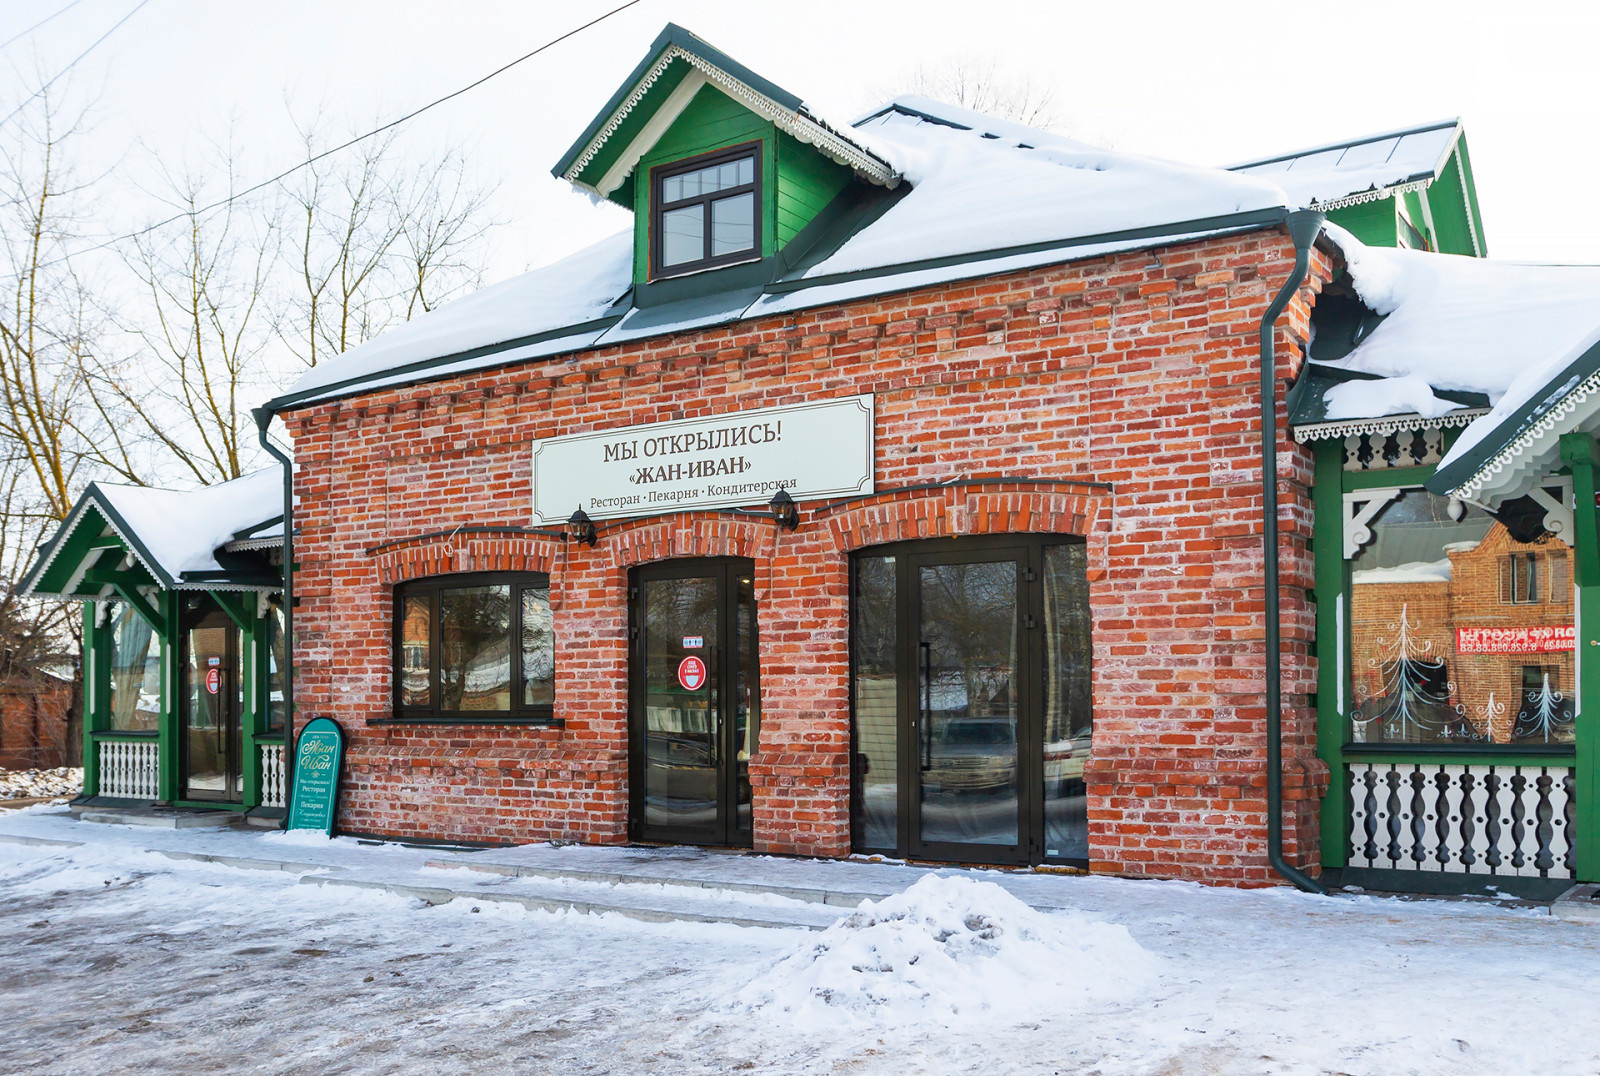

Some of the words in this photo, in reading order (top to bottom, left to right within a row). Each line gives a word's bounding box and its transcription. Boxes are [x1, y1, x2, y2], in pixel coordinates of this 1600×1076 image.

[603, 440, 638, 463] МЫ
[643, 420, 783, 458] ОТКРЫЛИСЬ!
[629, 456, 752, 485] «ЖАН-ИВАН»
[590, 494, 640, 508] Ресторан
[648, 488, 699, 503] Пекарня
[706, 478, 798, 498] Кондитерская
[302, 785, 326, 794] Ресторан
[300, 801, 324, 810] Пекарня
